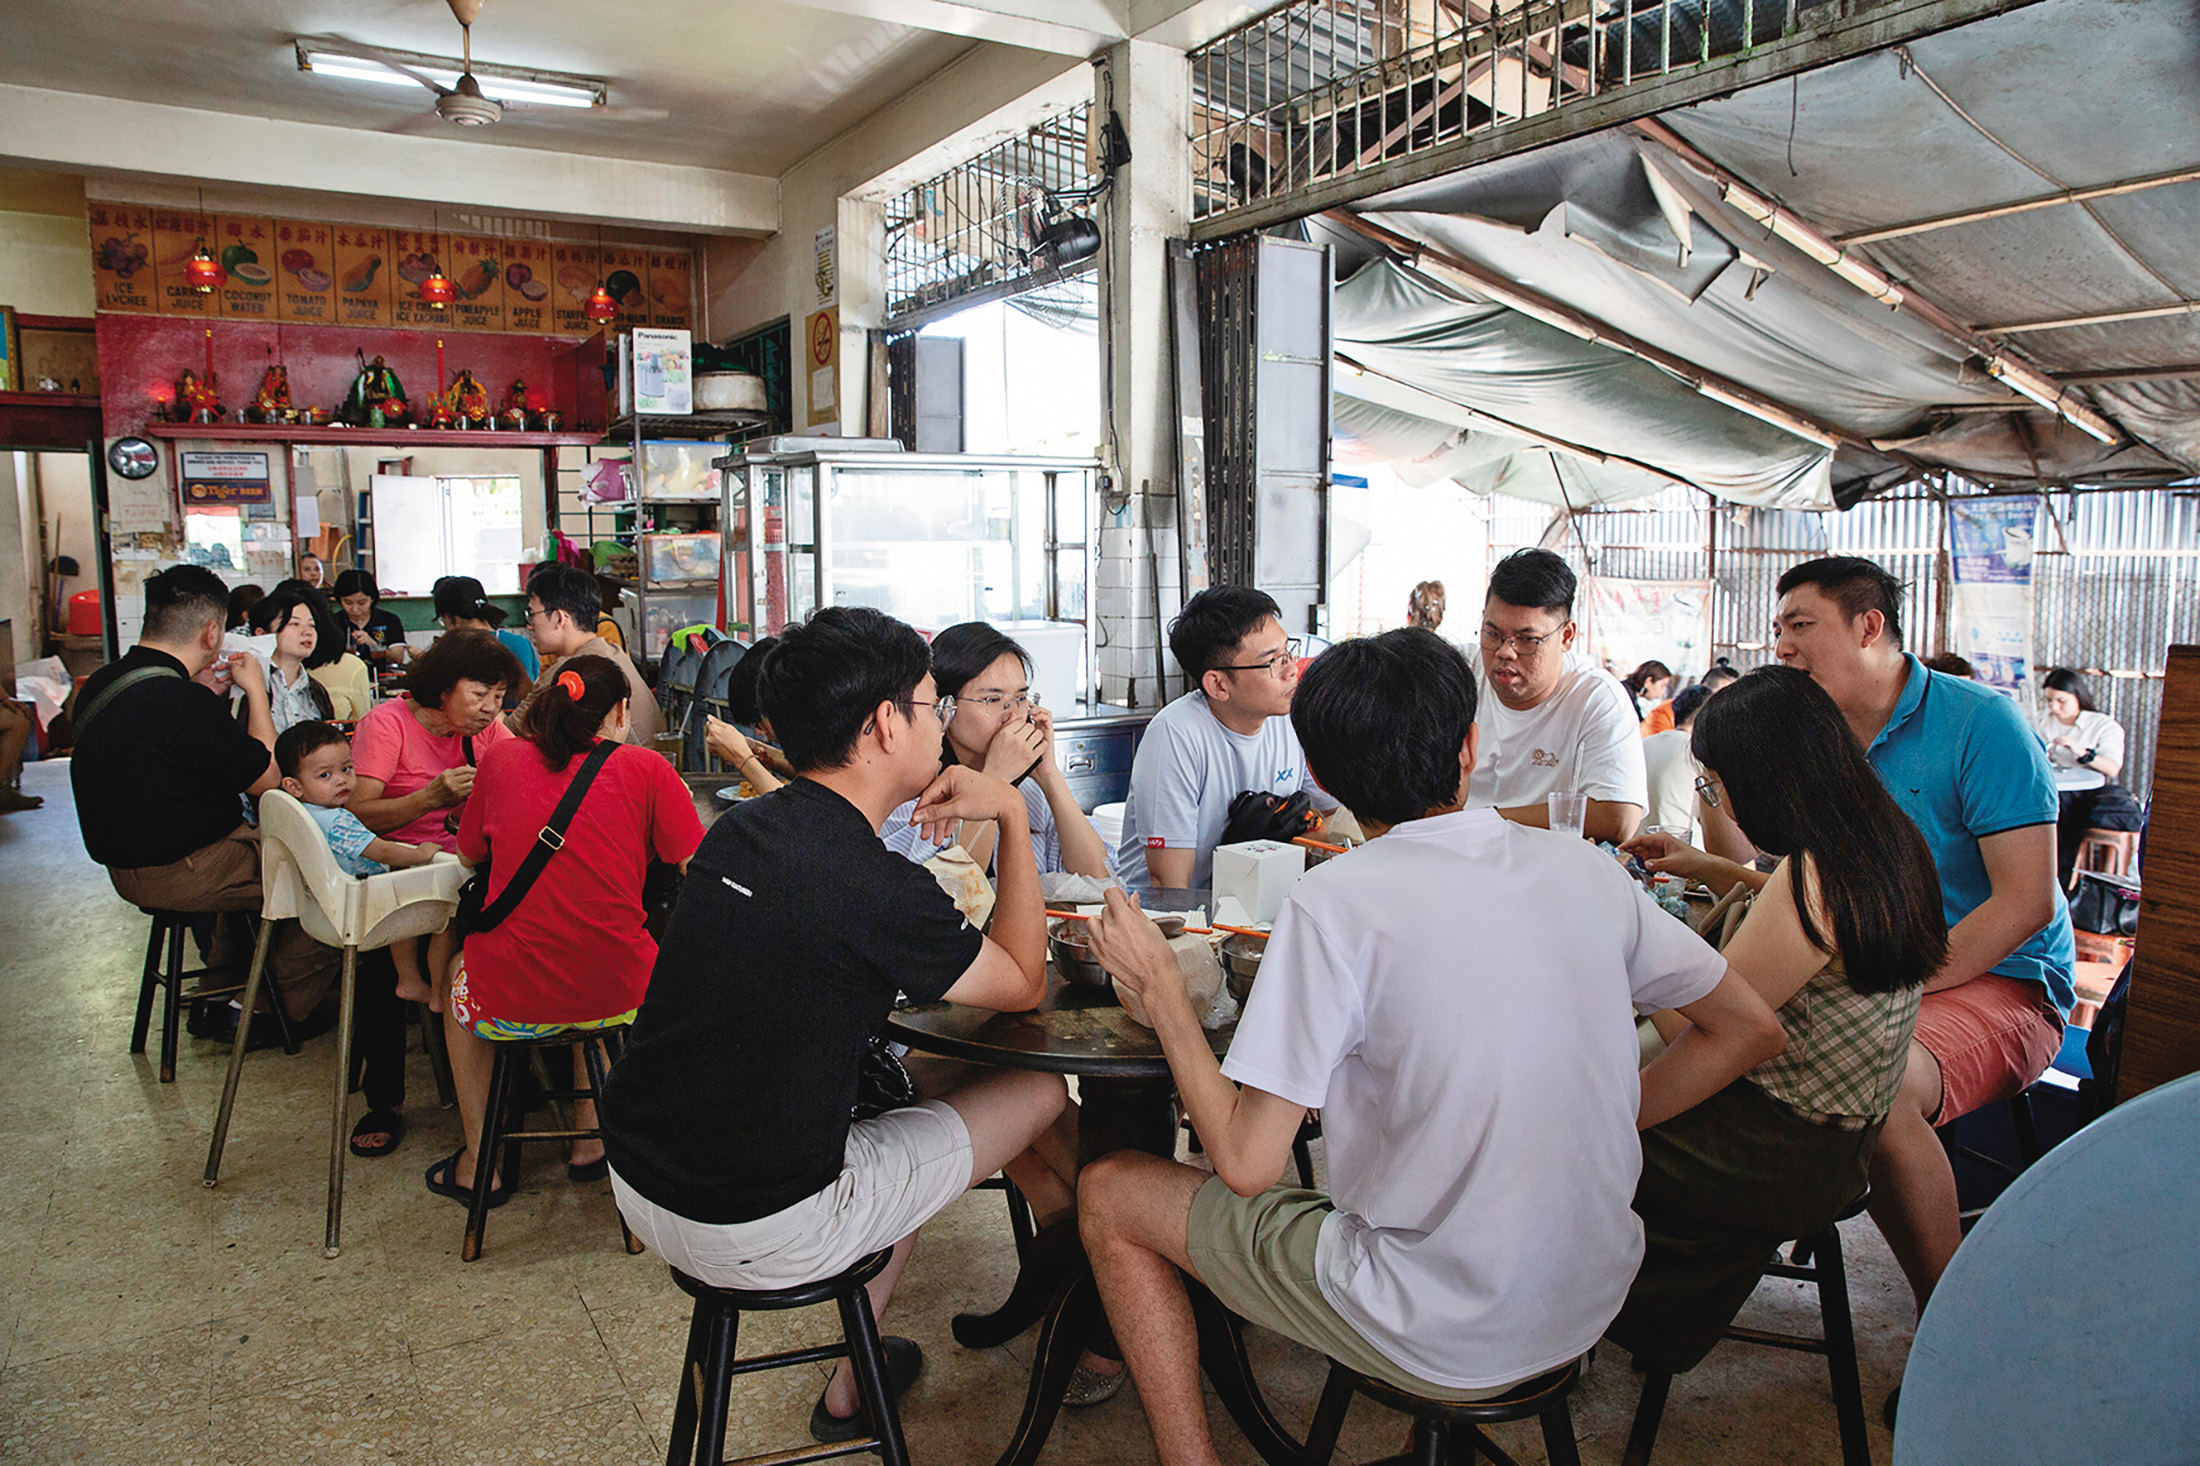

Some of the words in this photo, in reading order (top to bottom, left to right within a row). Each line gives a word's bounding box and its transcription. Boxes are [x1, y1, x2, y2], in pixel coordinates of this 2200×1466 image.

[114, 282, 133, 294] ICE
[106, 294, 147, 307] LYCHEE
[224, 290, 272, 303] COCONUT
[286, 293, 327, 306] TOMATO
[171, 299, 204, 310] JUICE
[230, 302, 265, 314] WATER
[342, 297, 379, 310] PAPAYA
[293, 306, 323, 318] JUICE
[346, 308, 376, 320] JUICE
[455, 304, 500, 317] PINEAPPLE
[513, 307, 542, 319] APPLE
[462, 316, 487, 326] JUICE
[514, 318, 541, 329] JUICE
[564, 321, 589, 331] JUICE
[655, 315, 685, 326] ORANGE
[637, 332, 679, 341] Panasonic
[207, 485, 238, 499] Tiger
[240, 487, 263, 496] BEER
